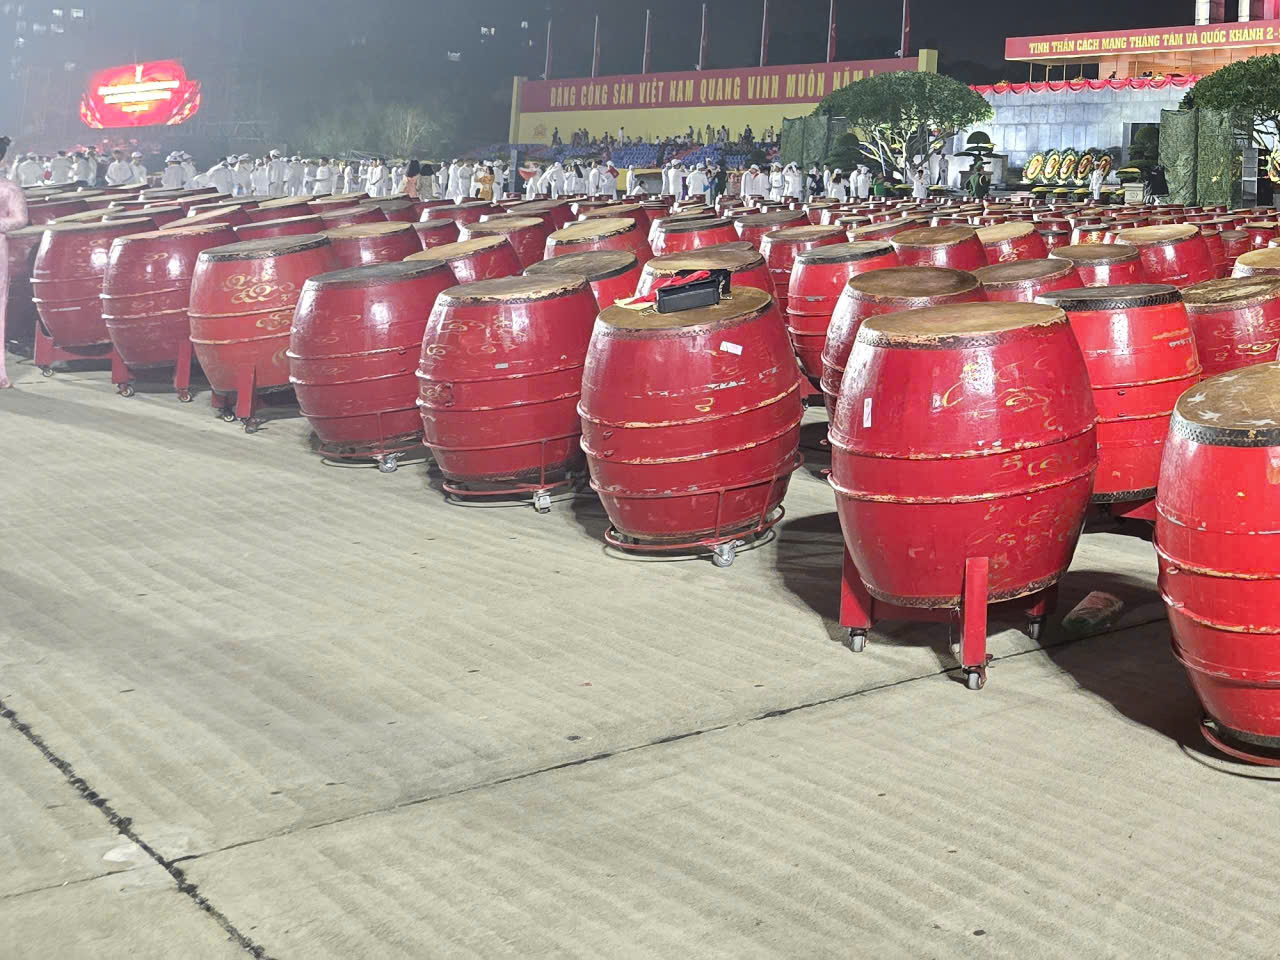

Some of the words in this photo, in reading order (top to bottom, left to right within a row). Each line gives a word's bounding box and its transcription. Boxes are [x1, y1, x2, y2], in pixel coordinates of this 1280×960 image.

[1029, 41, 1050, 54] TINH
[1101, 36, 1127, 52] MẠNG
[1129, 32, 1161, 48] THÁNG
[1162, 31, 1184, 46] TÁM
[1186, 29, 1199, 45] VÀ
[1200, 26, 1226, 44] QUỐC
[1229, 25, 1264, 42] KHÁNH
[550, 82, 576, 107] ĐẢNG
[580, 81, 608, 109] CỘNG
[613, 79, 634, 105] SẢN
[639, 77, 665, 107] VIỆT
[669, 79, 695, 103] NAM
[699, 77, 741, 104] QUANG
[748, 74, 780, 100] VINH
[786, 69, 826, 98] MUÔN
